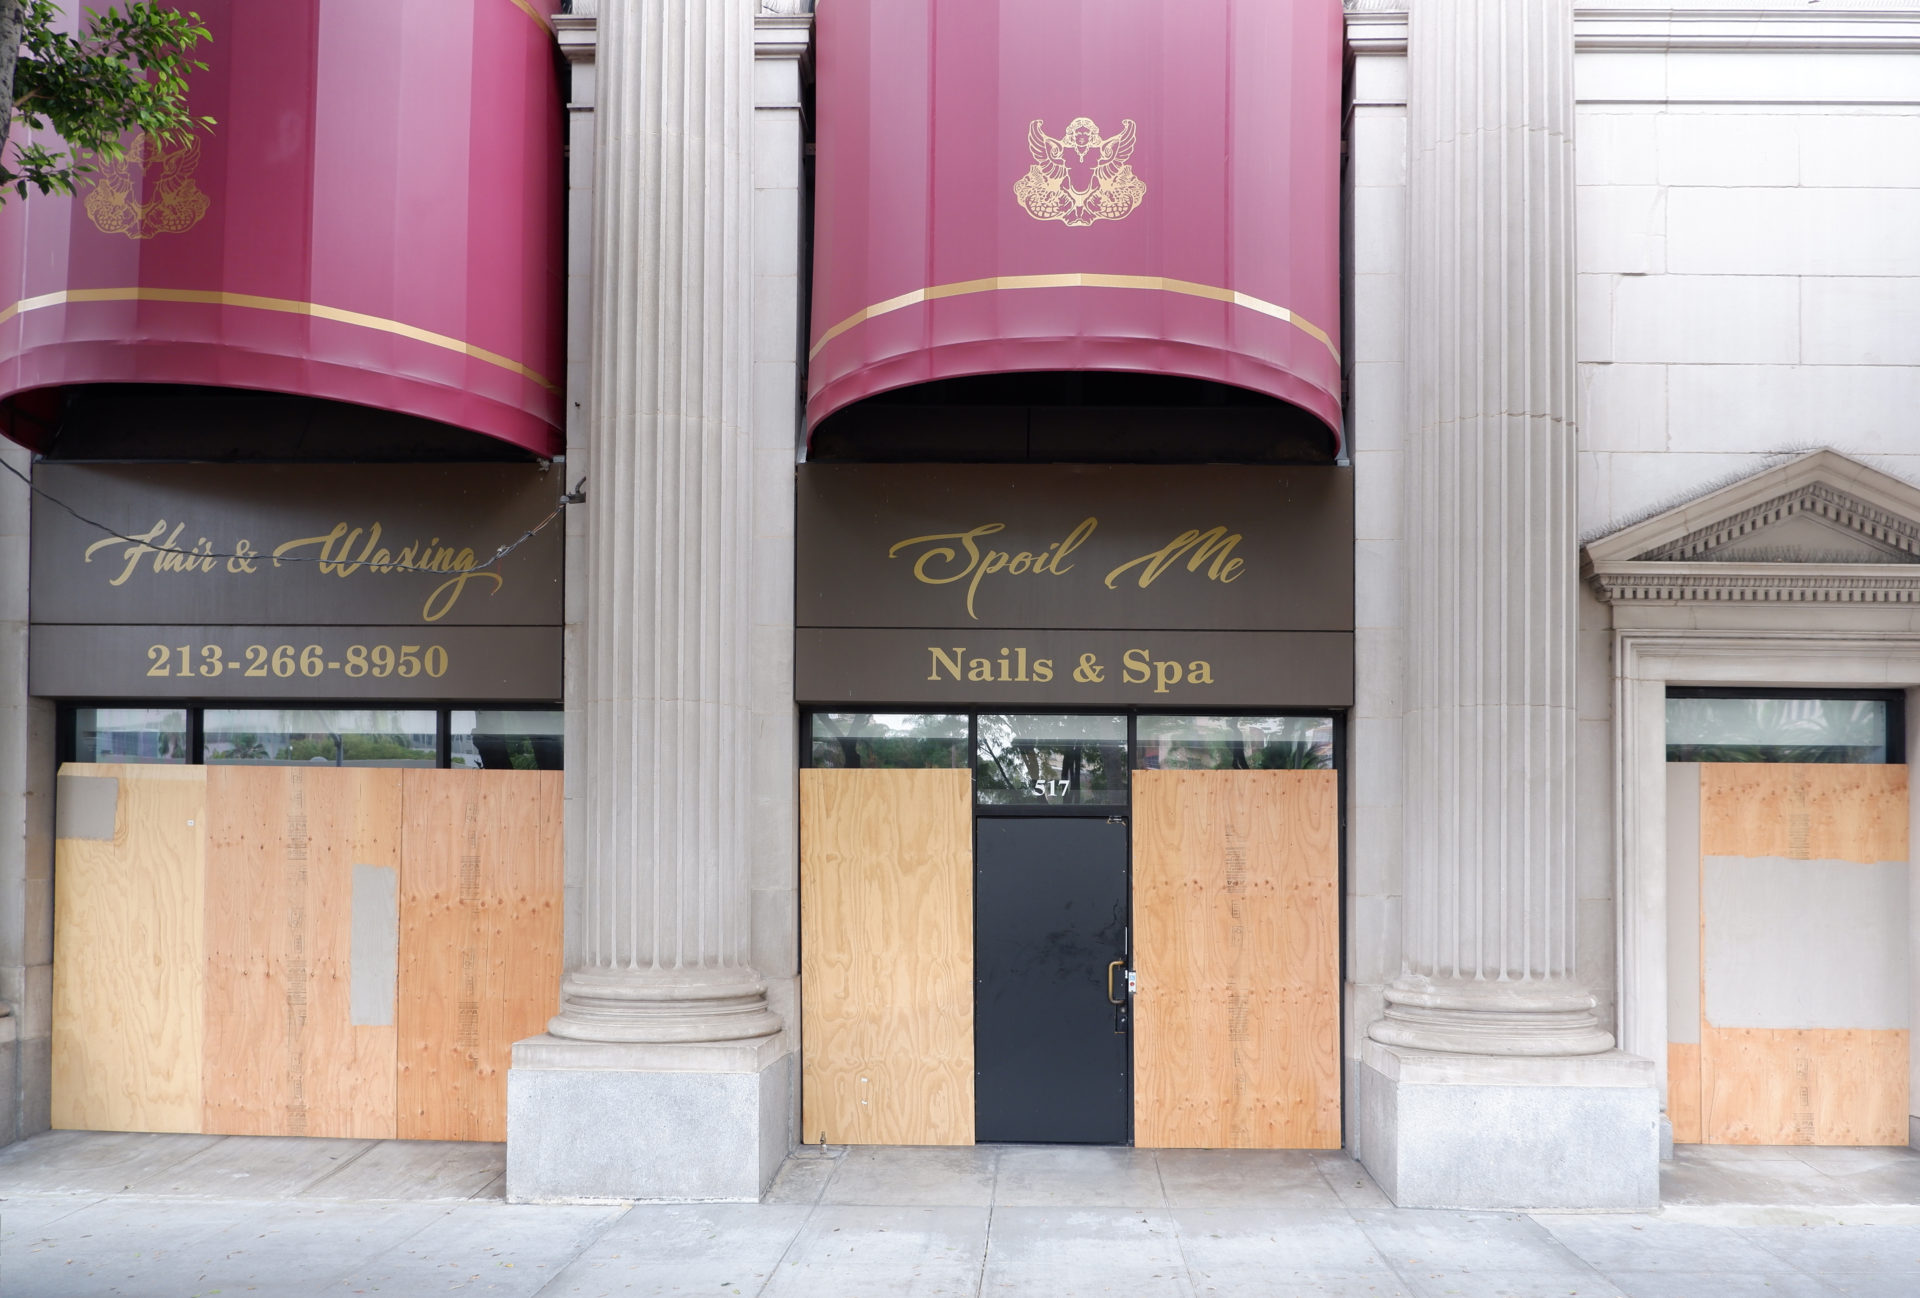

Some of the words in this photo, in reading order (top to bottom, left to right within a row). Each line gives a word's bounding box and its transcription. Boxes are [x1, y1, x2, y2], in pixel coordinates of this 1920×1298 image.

[85, 519, 217, 586] Hair
[227, 539, 258, 573] &
[273, 521, 502, 621] Waxing
[888, 517, 1099, 620] Spoil
[1104, 525, 1245, 590] Me
[147, 644, 449, 678] 213-266-8950
[927, 647, 1053, 682] Nails
[1072, 652, 1104, 683] &
[1122, 648, 1214, 693] Spa
[1033, 779, 1070, 797] 517
